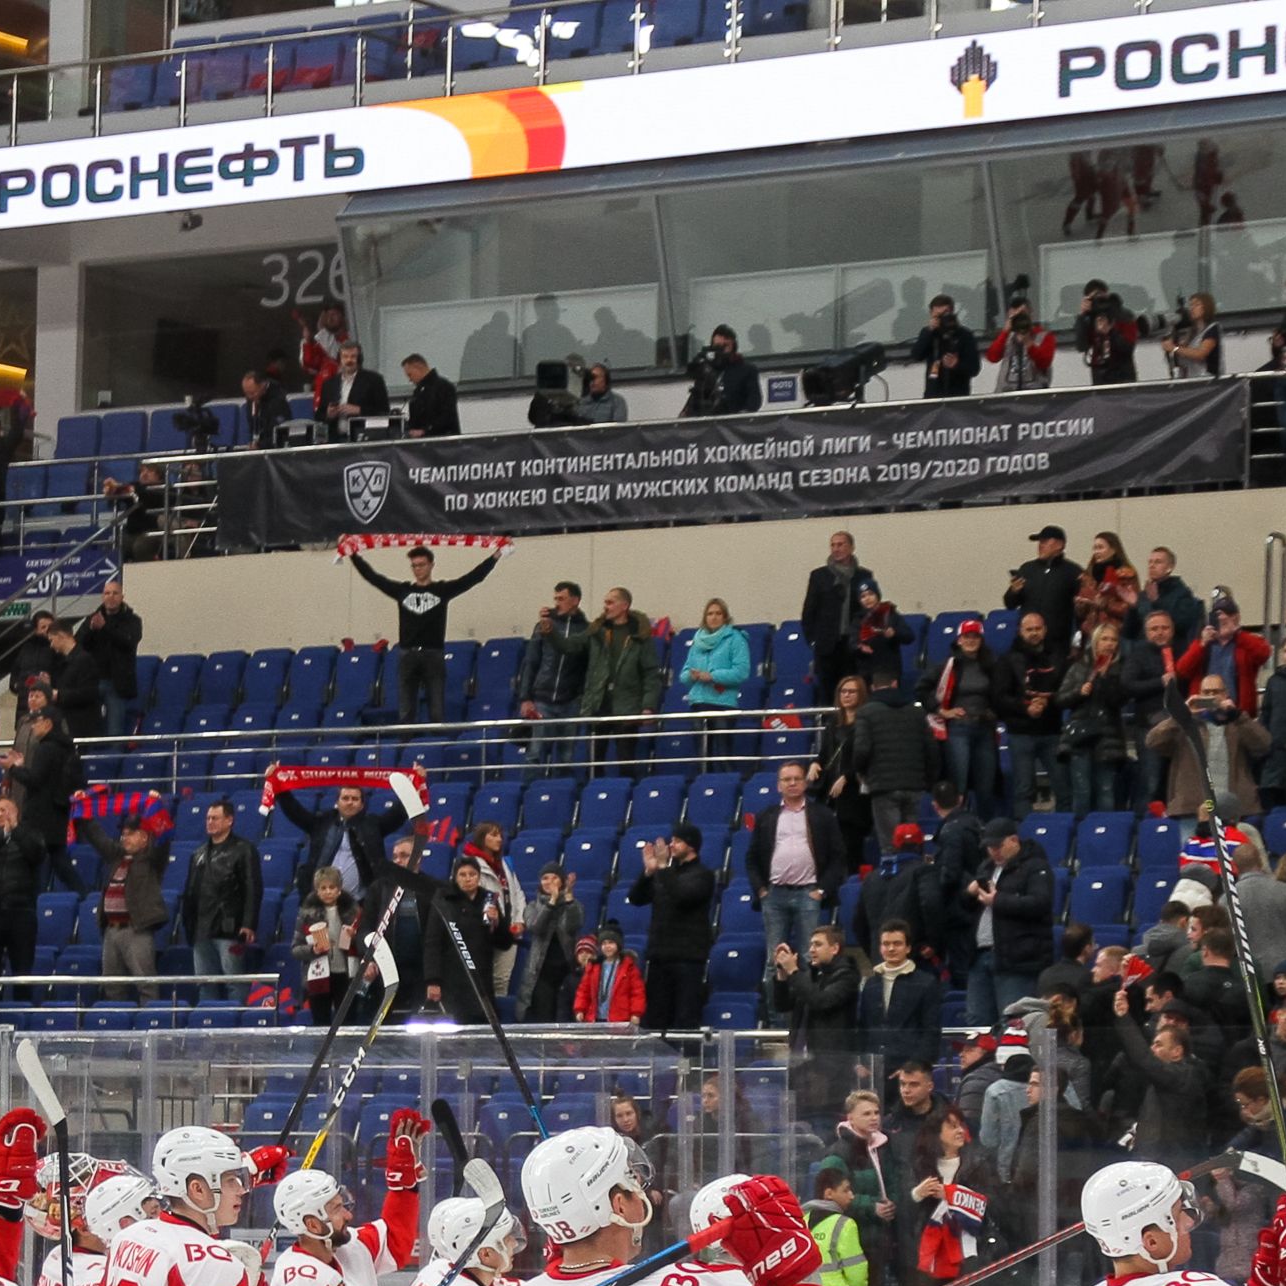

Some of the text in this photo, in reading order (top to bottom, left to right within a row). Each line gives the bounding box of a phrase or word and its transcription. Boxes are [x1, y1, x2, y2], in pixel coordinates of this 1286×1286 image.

[408, 416, 1095, 485] ЧЕМПИОНАТ КОНТИНЕНТАЛЬНОЙ ХОККЕЙНОЙ ЛИГИ ЧЕМПИОНАТ РОССИИ
[444, 452, 1051, 512] ПО ХОККЕЮ СРЕДИ МУЖСКИХ КОМАНД СЕЗОНА 2019/2020 ГОДОВ
[332, 1046, 365, 1108] CCM
[542, 1220, 576, 1241] 38
[183, 1242, 234, 1263] BQ
[283, 1264, 319, 1284] BQ
